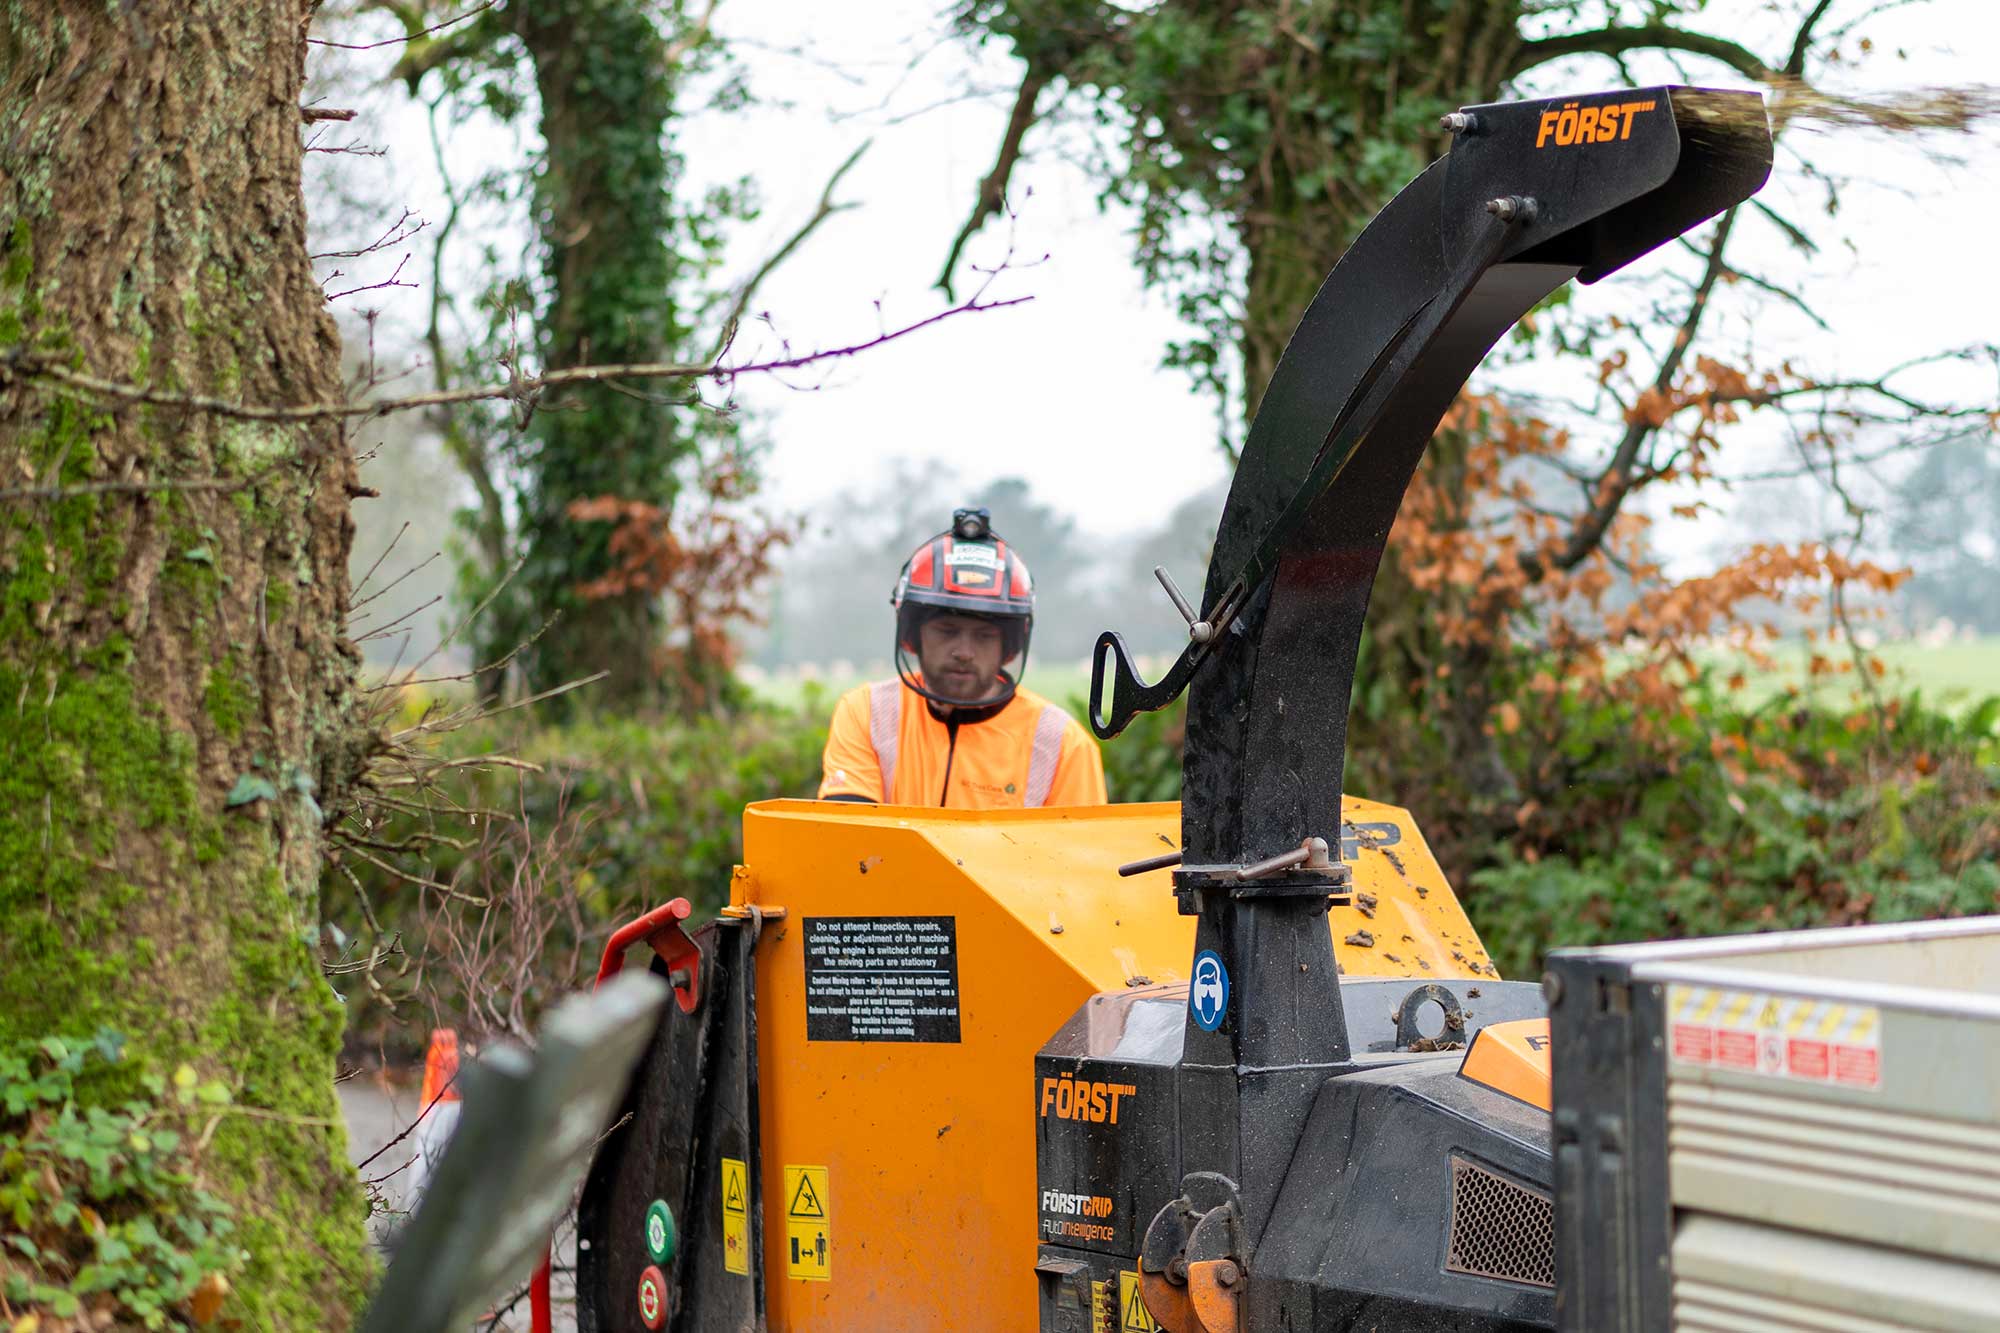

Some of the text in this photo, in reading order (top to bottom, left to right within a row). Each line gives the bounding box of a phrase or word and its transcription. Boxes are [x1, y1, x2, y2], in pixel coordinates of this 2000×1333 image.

[1536, 100, 1656, 148] FÖRST
[816, 922, 941, 933] Do not attempt inspection, repairs,
[809, 934, 841, 944] cleaning,
[853, 934, 893, 944] adjustment
[894, 934, 903, 943] of
[905, 934, 917, 943] the
[919, 934, 949, 943] machine
[810, 946, 949, 958] until the engine is switched off and all
[823, 957, 836, 966] the
[838, 958, 864, 968] moving
[865, 958, 884, 968] parts
[900, 958, 937, 968] stationary
[1040, 1072, 1137, 1125] FÖRST
